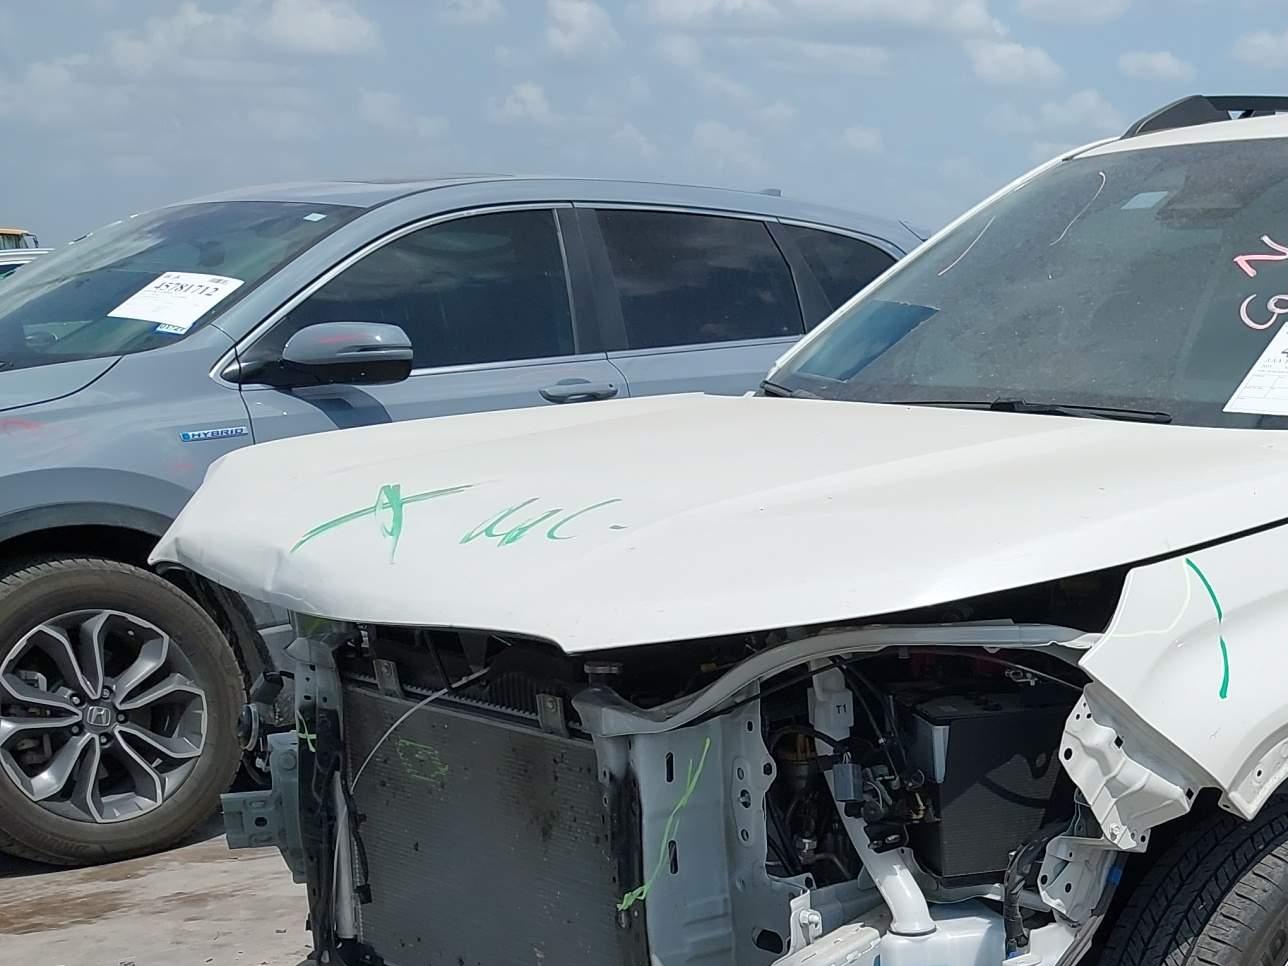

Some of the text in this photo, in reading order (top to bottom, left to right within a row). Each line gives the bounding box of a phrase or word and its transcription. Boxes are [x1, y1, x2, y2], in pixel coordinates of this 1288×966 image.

[154, 281, 220, 297] 45781712
[191, 427, 244, 438] HYBRID
[835, 703, 847, 714] T1
